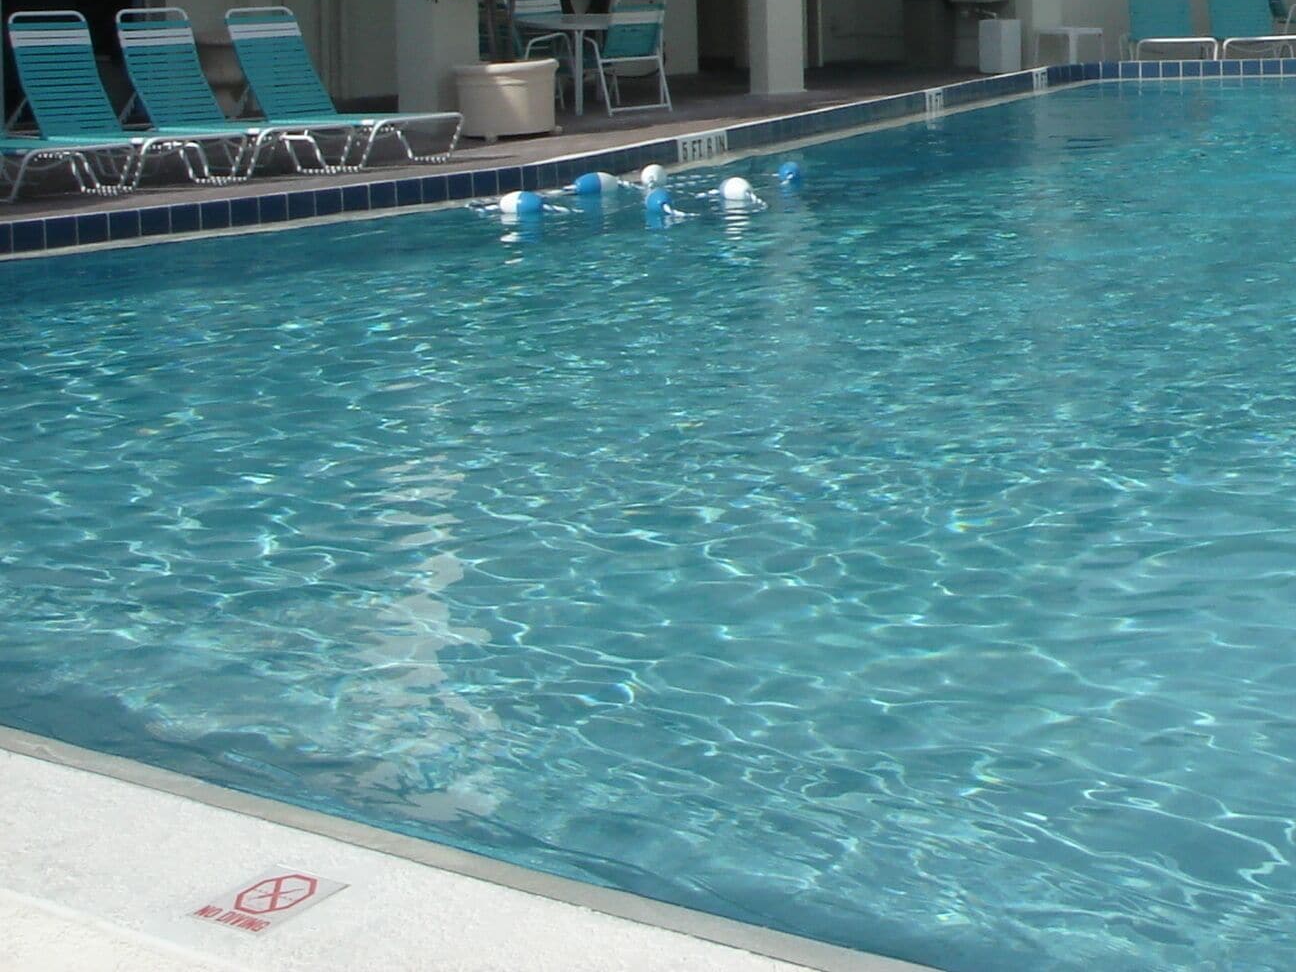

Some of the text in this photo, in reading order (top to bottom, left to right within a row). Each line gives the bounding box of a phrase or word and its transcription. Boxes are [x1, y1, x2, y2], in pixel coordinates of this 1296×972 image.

[682, 141, 688, 161] 5
[692, 139, 703, 160] FT
[715, 135, 726, 156] IN
[193, 905, 271, 932] NO DIVING
